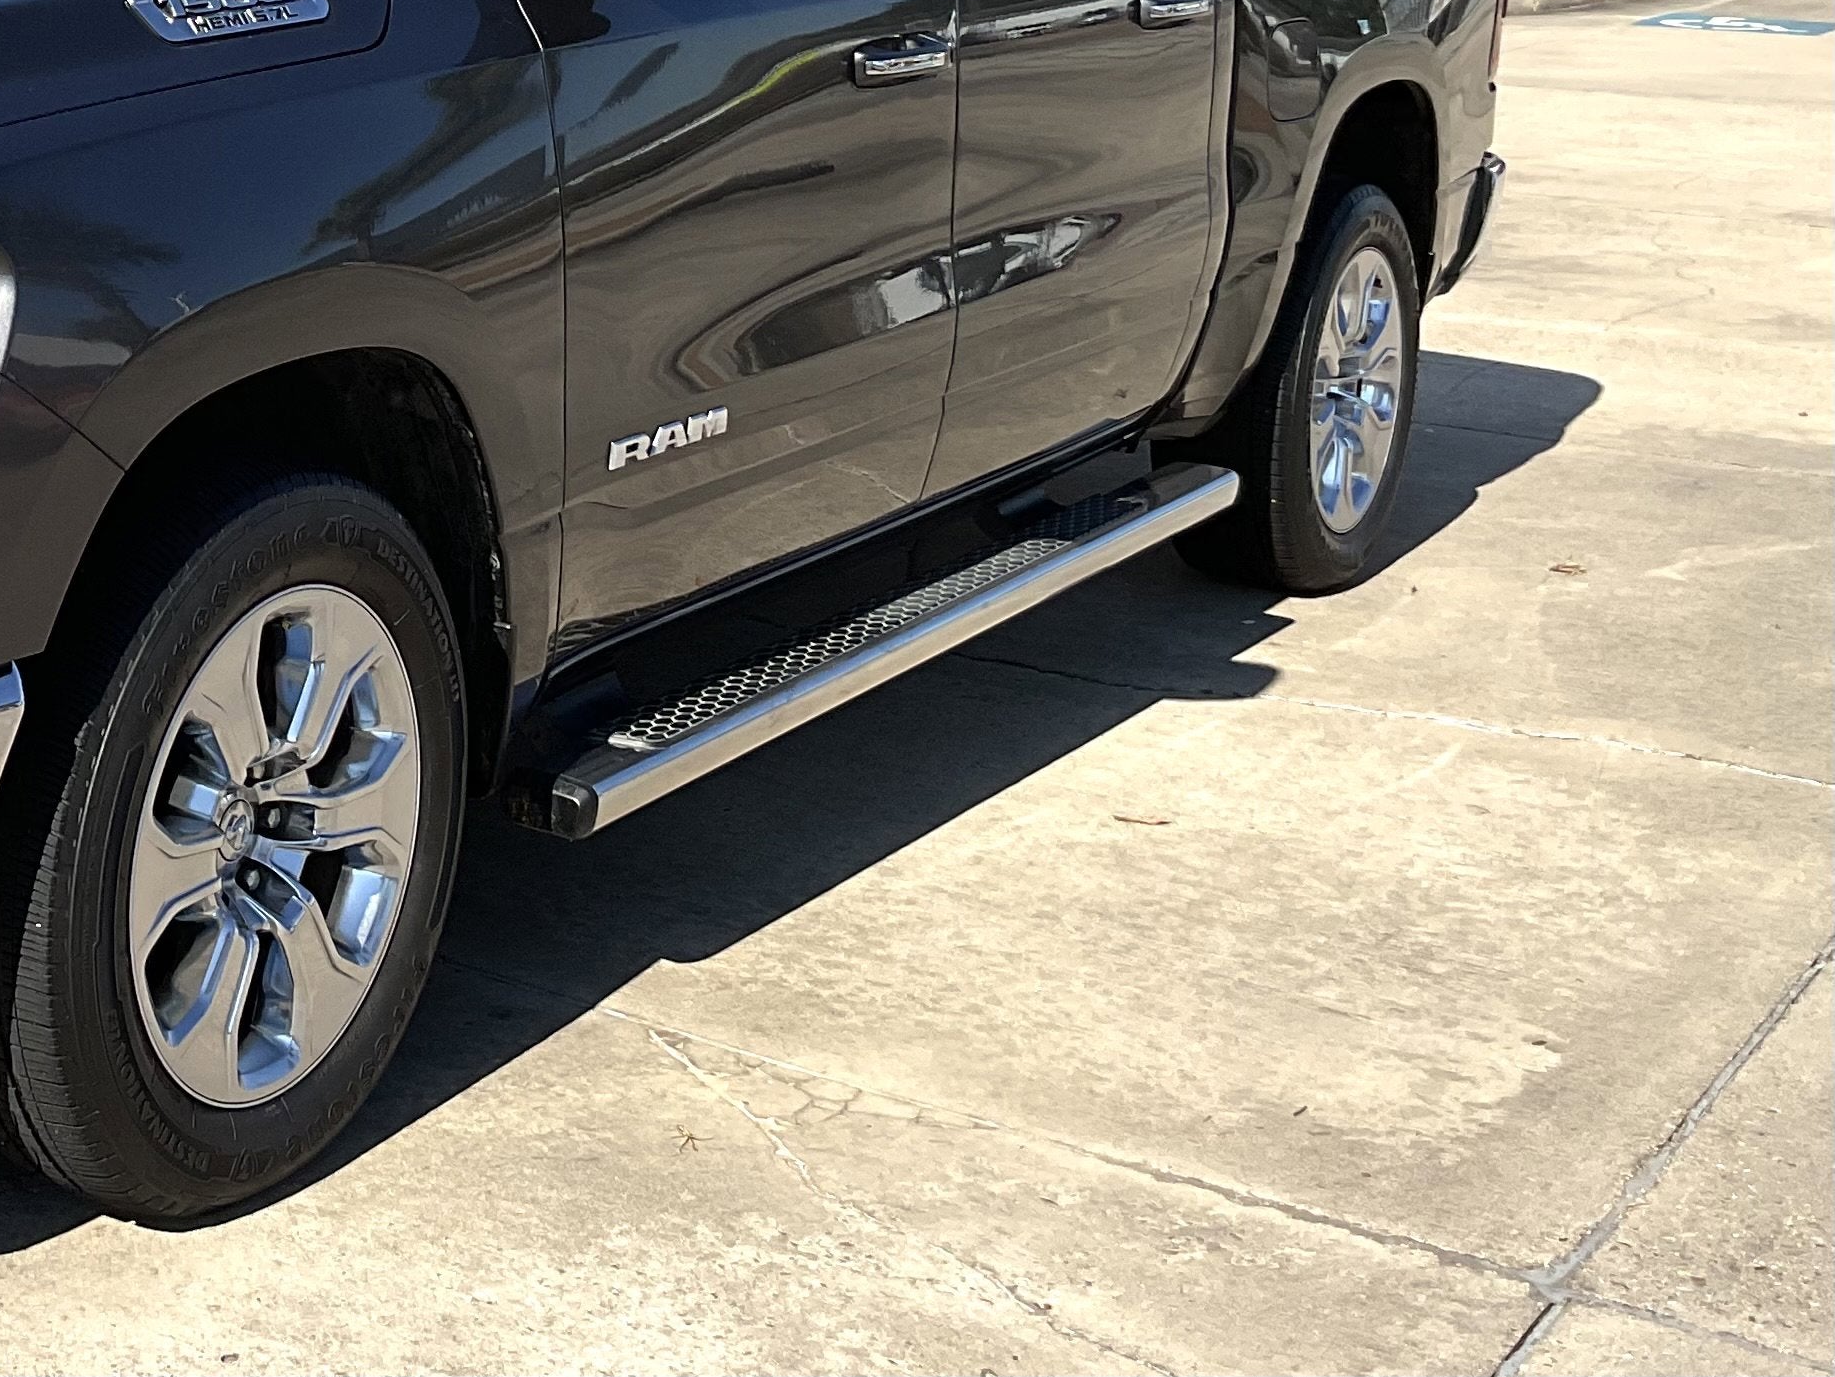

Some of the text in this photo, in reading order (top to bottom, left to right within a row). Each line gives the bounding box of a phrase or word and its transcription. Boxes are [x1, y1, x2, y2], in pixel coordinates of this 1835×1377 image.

[186, 5, 299, 35] HEMI 5.7L
[607, 405, 729, 472] RAM
[374, 535, 455, 672] DESTINATION
